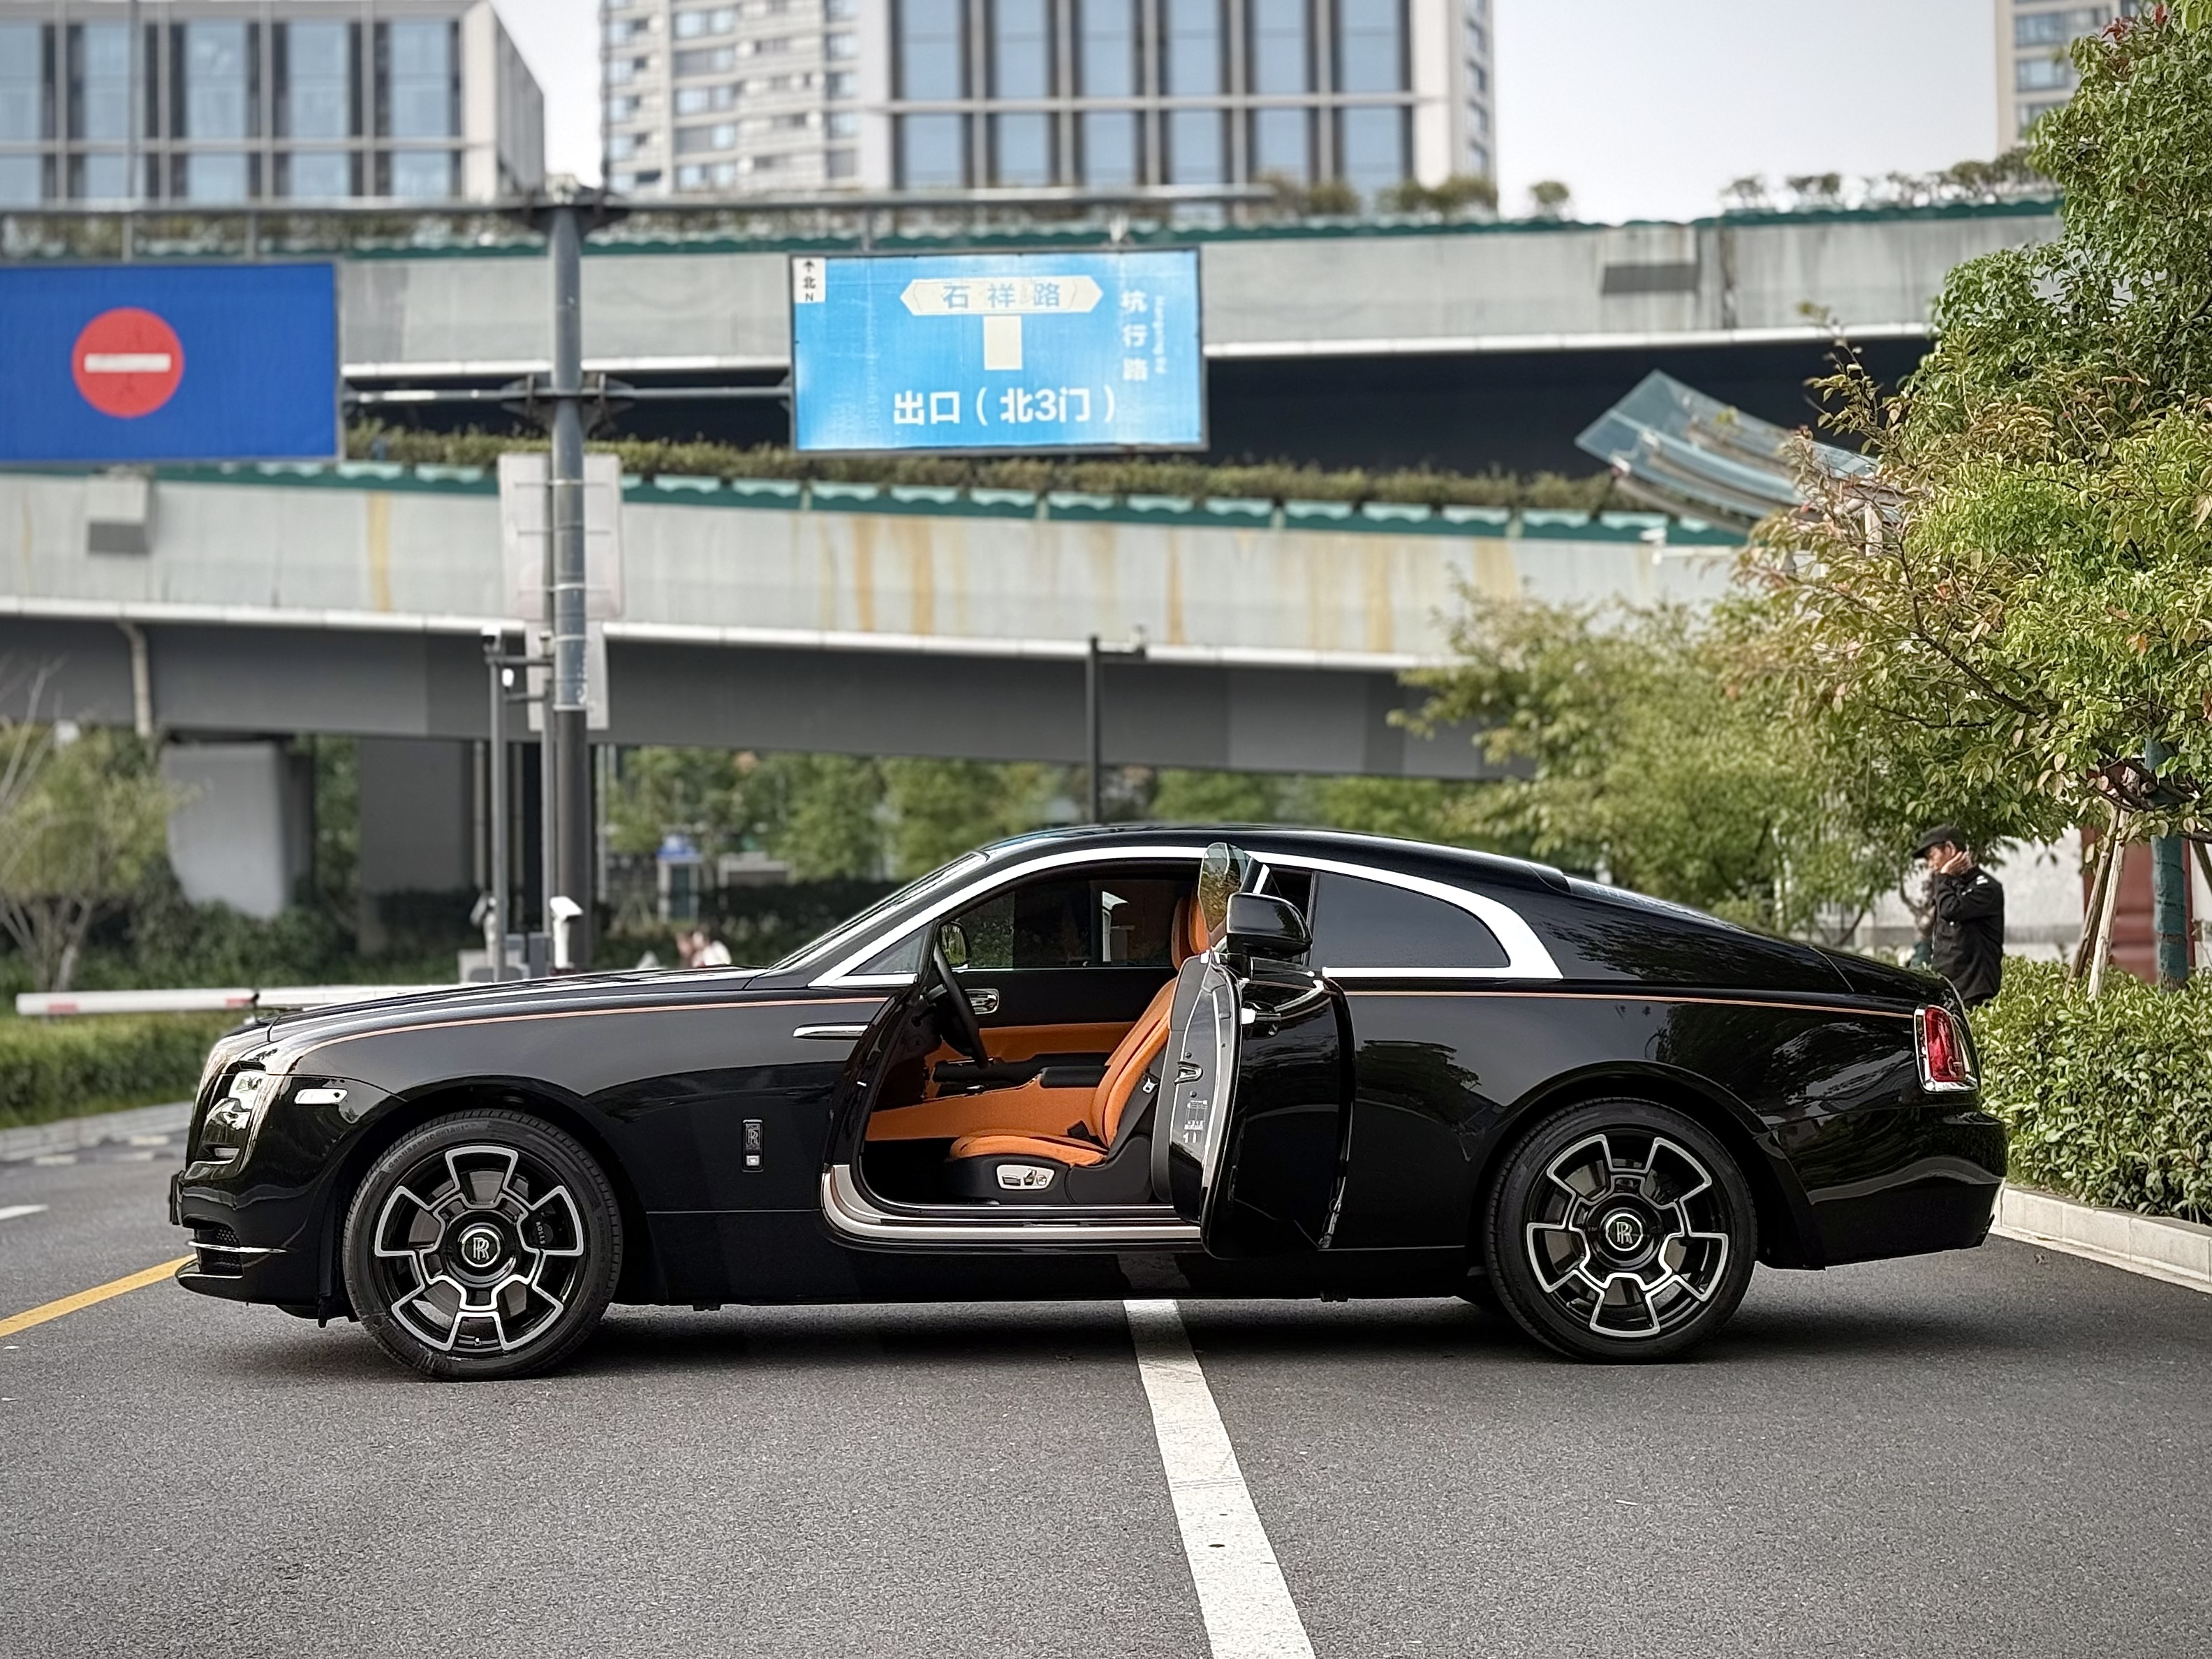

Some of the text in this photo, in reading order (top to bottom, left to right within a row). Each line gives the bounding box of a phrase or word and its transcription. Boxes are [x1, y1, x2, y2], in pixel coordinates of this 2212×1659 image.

[803, 276, 816, 289] 北
[805, 293, 813, 302] N
[943, 282, 1060, 309] 石祥路
